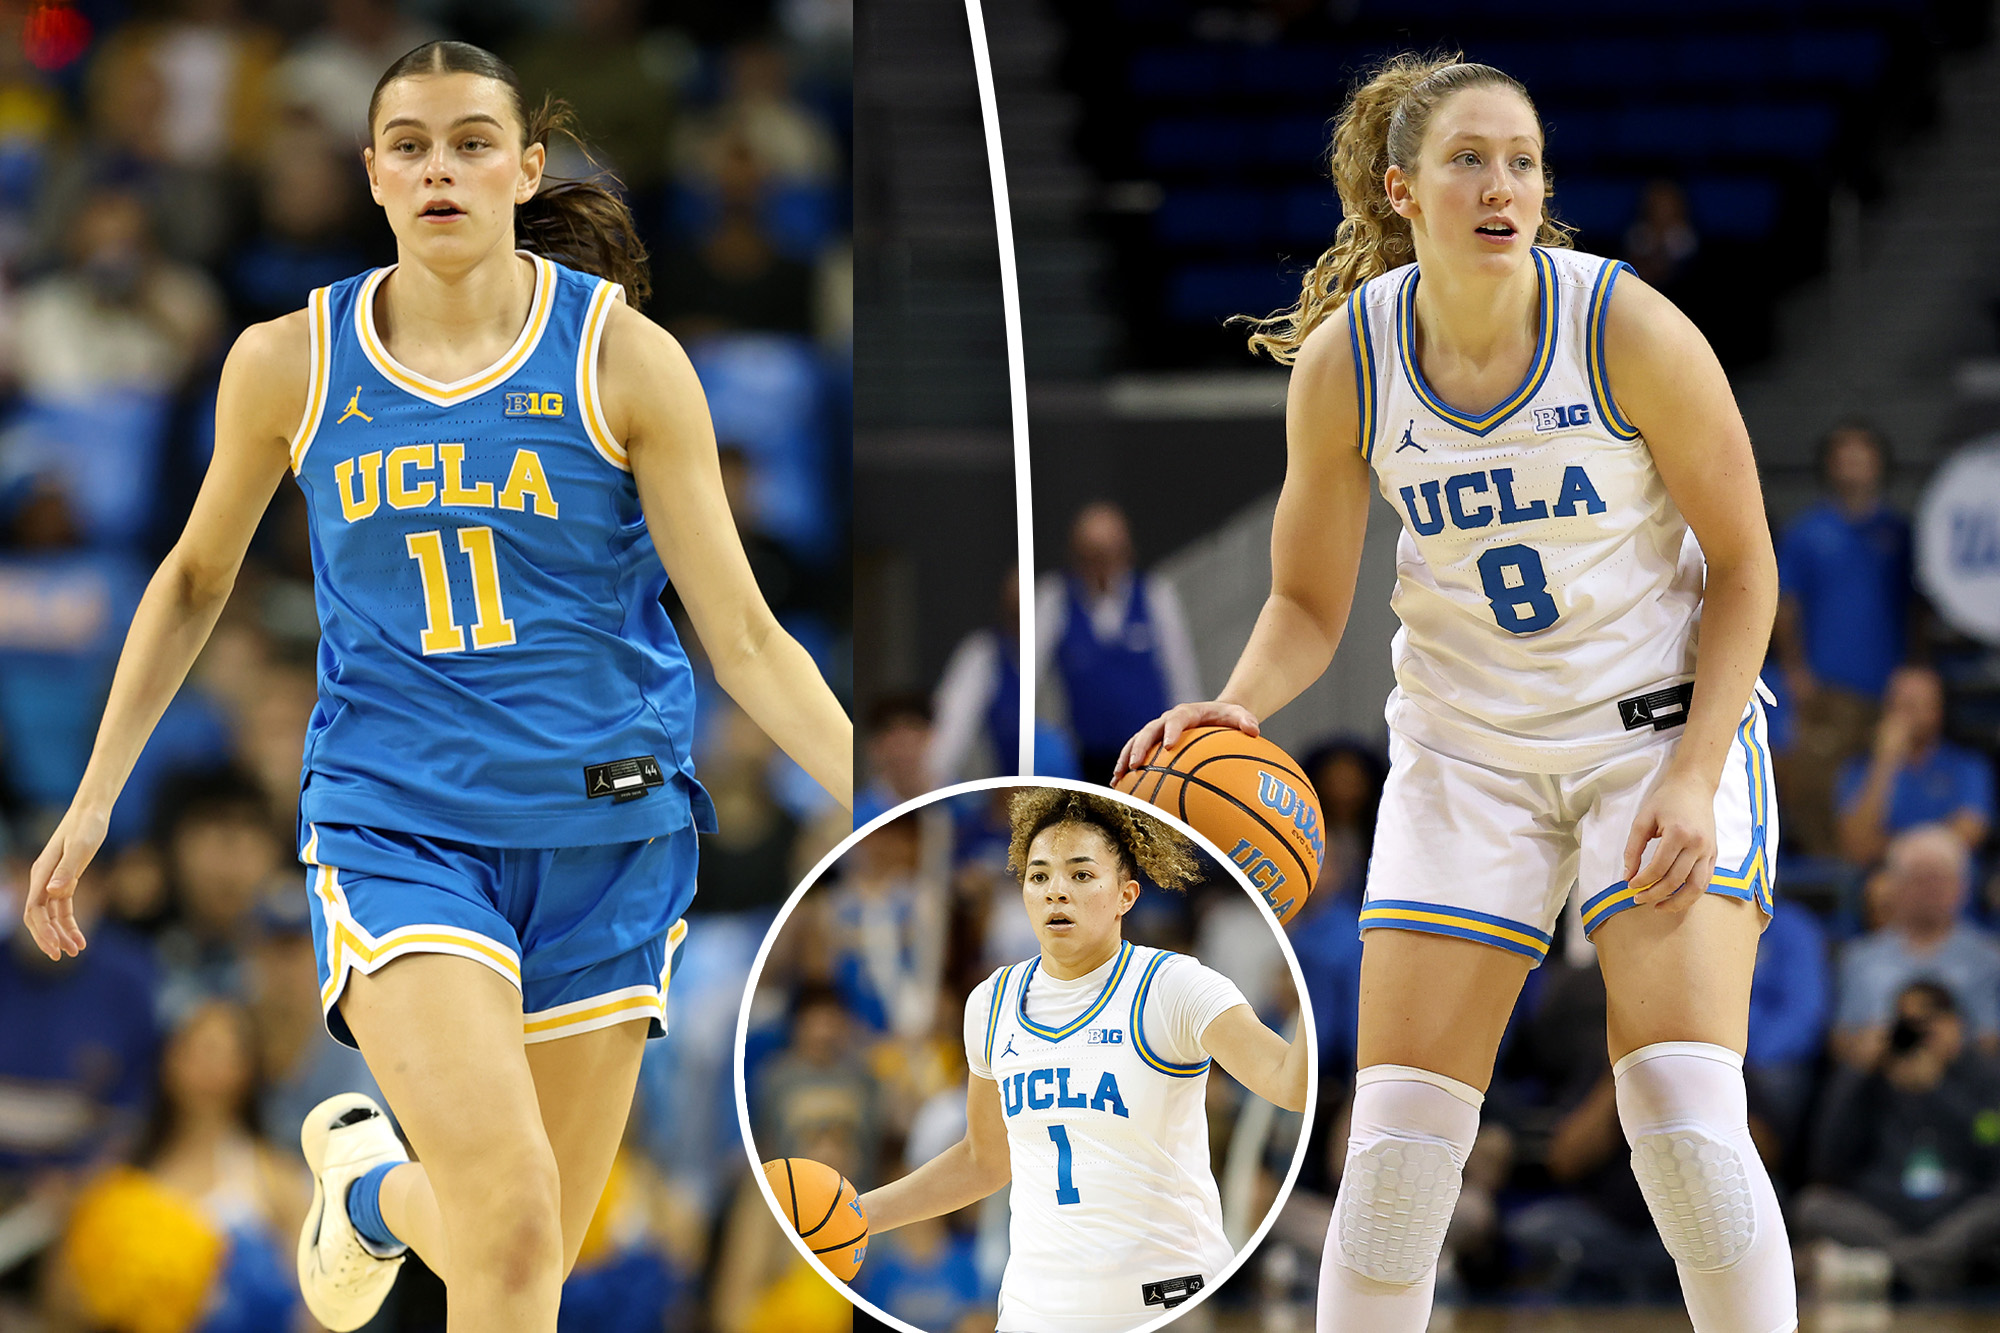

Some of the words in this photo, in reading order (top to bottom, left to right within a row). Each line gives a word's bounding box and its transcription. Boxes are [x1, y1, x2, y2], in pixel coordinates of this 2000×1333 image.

[334, 443, 558, 523] UCLA
[1399, 466, 1606, 536] UCLA
[405, 526, 517, 656] 11
[1477, 543, 1560, 634] 8
[645, 764, 658, 776] 44
[1292, 829, 1305, 845] EVO
[1227, 838, 1295, 919] UCLA
[1003, 1068, 1129, 1118] UCLA
[1047, 1124, 1080, 1205] 1
[1190, 1281, 1201, 1290] 42
